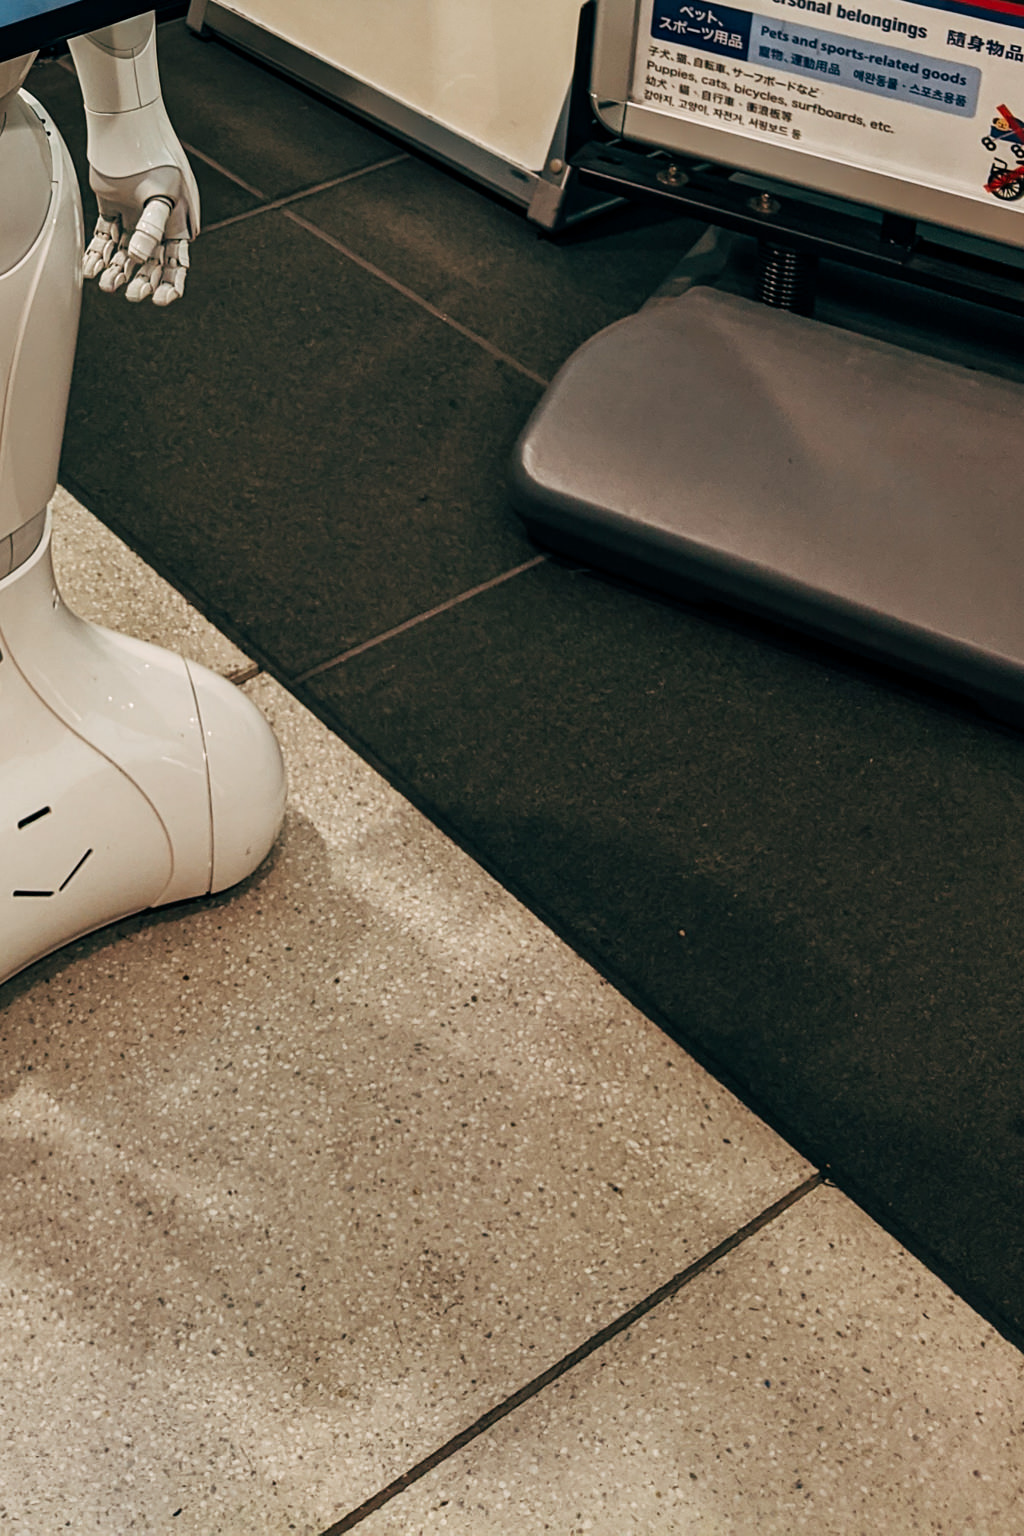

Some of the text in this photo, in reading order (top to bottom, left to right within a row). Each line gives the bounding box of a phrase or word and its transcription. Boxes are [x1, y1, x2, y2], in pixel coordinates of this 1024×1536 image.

[660, 17, 742, 49] スポーツ用品
[680, 7, 723, 26] ペット、
[837, 5, 927, 39] belongings
[648, 46, 819, 98] 子犬、猫、自転車、サーフボードなど
[761, 26, 966, 85] Pets and sports-related goods
[647, 60, 894, 133] Puppies, cats, bicycles, surfboards, etc.
